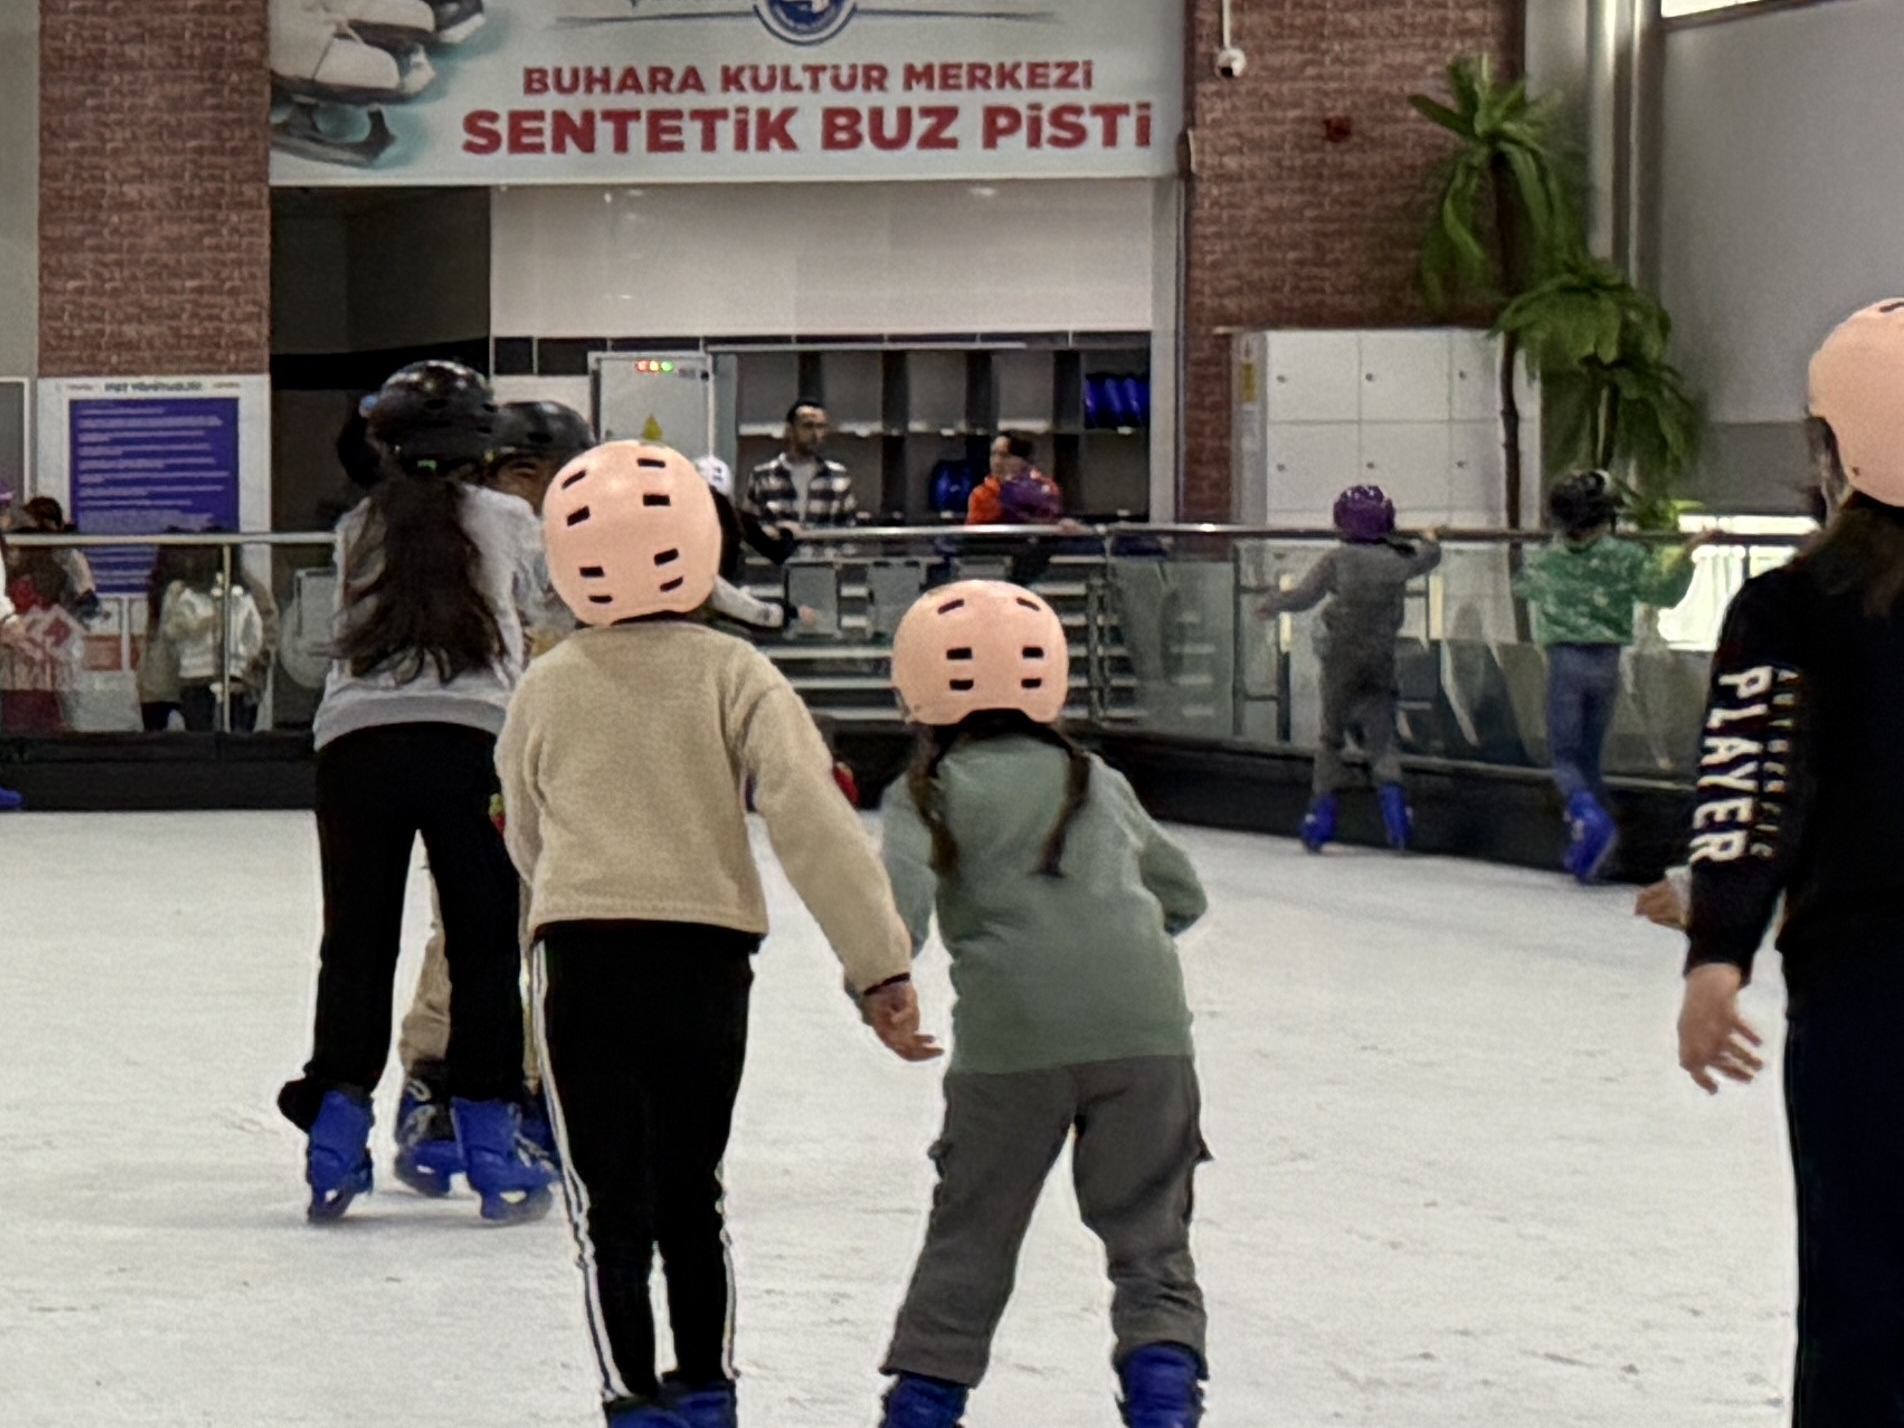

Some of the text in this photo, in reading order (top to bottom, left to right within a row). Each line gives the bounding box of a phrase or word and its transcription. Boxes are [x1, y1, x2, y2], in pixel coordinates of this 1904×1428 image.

[522, 66, 705, 96] BUHARA
[902, 60, 1095, 92] MERKEZİ
[461, 100, 1154, 156] SENTETİK BUZ PİSTİ
[1687, 664, 1775, 866] PLAYER
